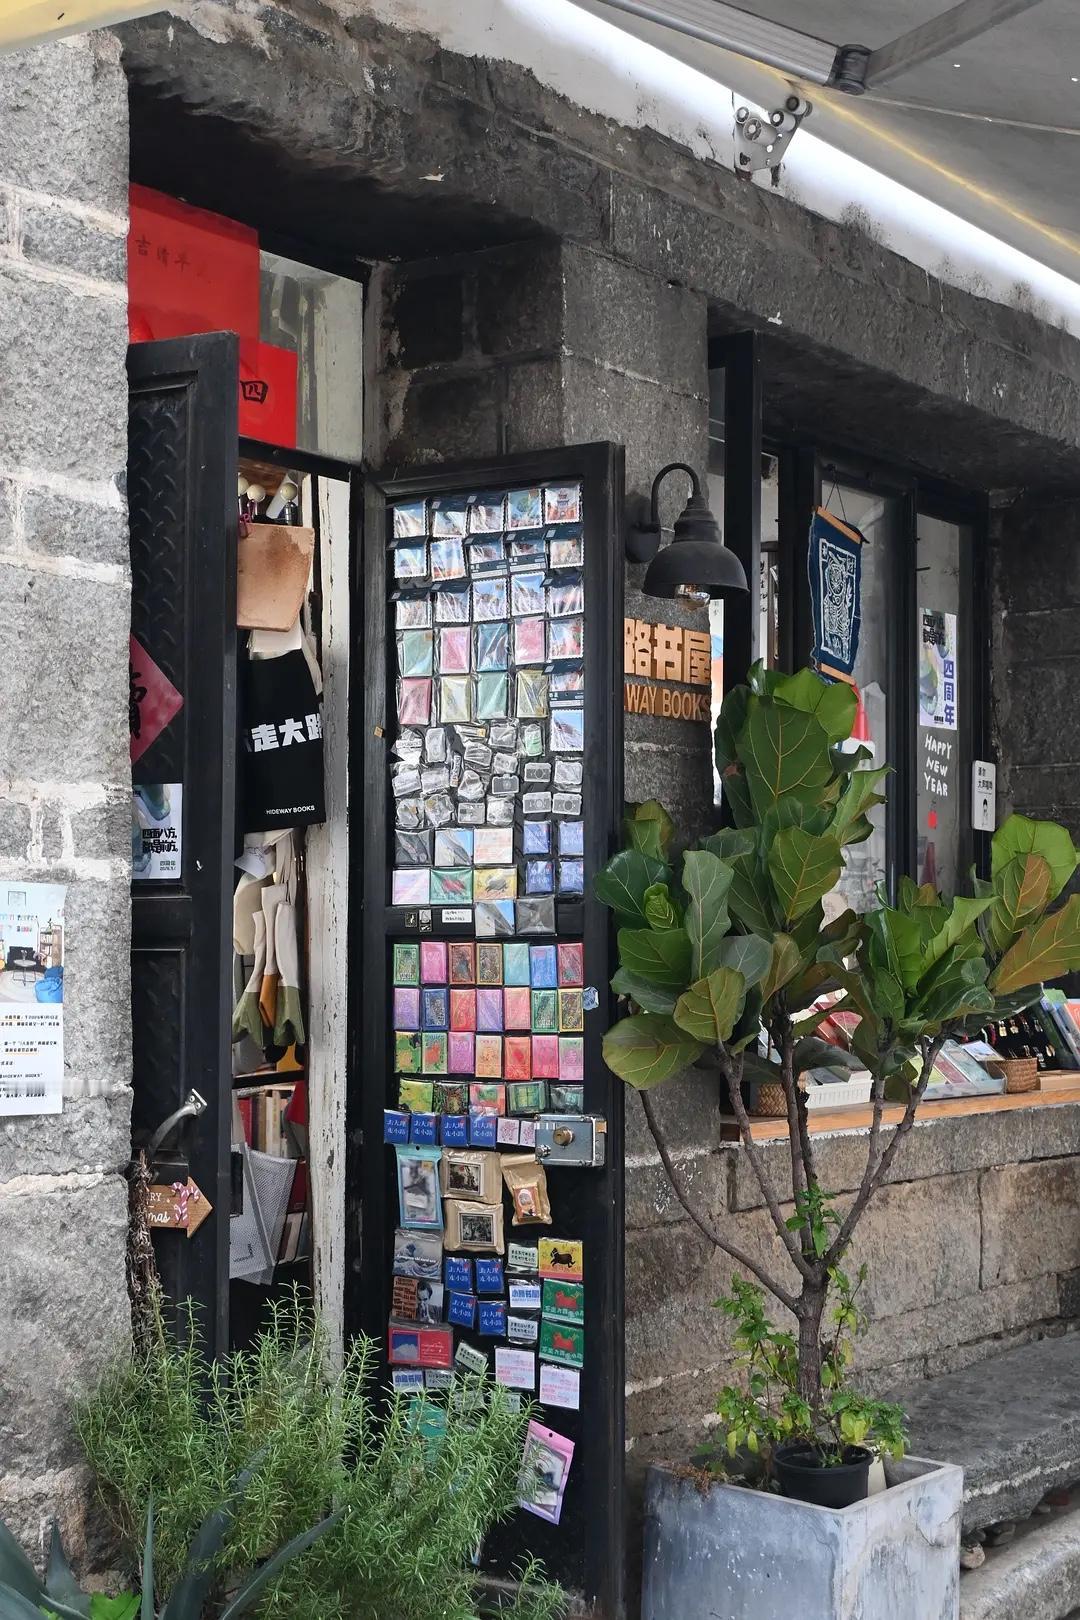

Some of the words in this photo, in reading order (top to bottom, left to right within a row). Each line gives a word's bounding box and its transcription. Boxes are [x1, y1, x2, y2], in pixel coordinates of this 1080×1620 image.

[662, 689, 710, 721] BOOKS
[924, 733, 952, 760] HAPPY
[926, 756, 948, 777] NEW
[924, 772, 948, 797] YEAR
[266, 807, 292, 815] HIDEWAY
[293, 805, 315, 813] BOOKS
